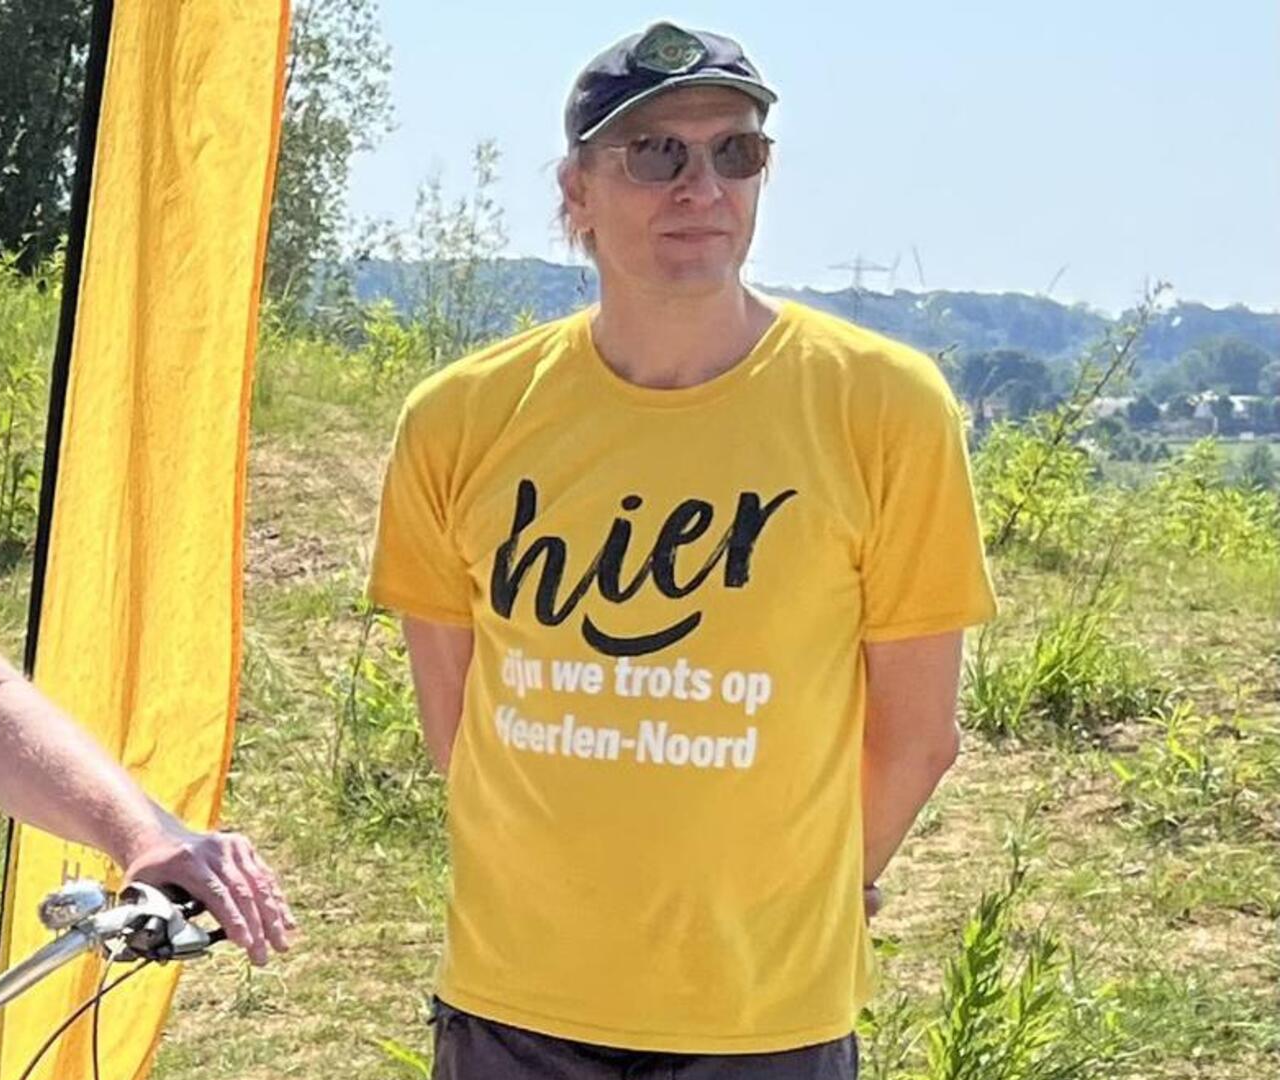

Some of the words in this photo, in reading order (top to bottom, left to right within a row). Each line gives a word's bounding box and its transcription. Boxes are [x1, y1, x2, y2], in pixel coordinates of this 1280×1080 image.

[490, 479, 797, 626] hier
[551, 659, 604, 694] we
[614, 656, 713, 701] trots
[721, 670, 772, 716] op
